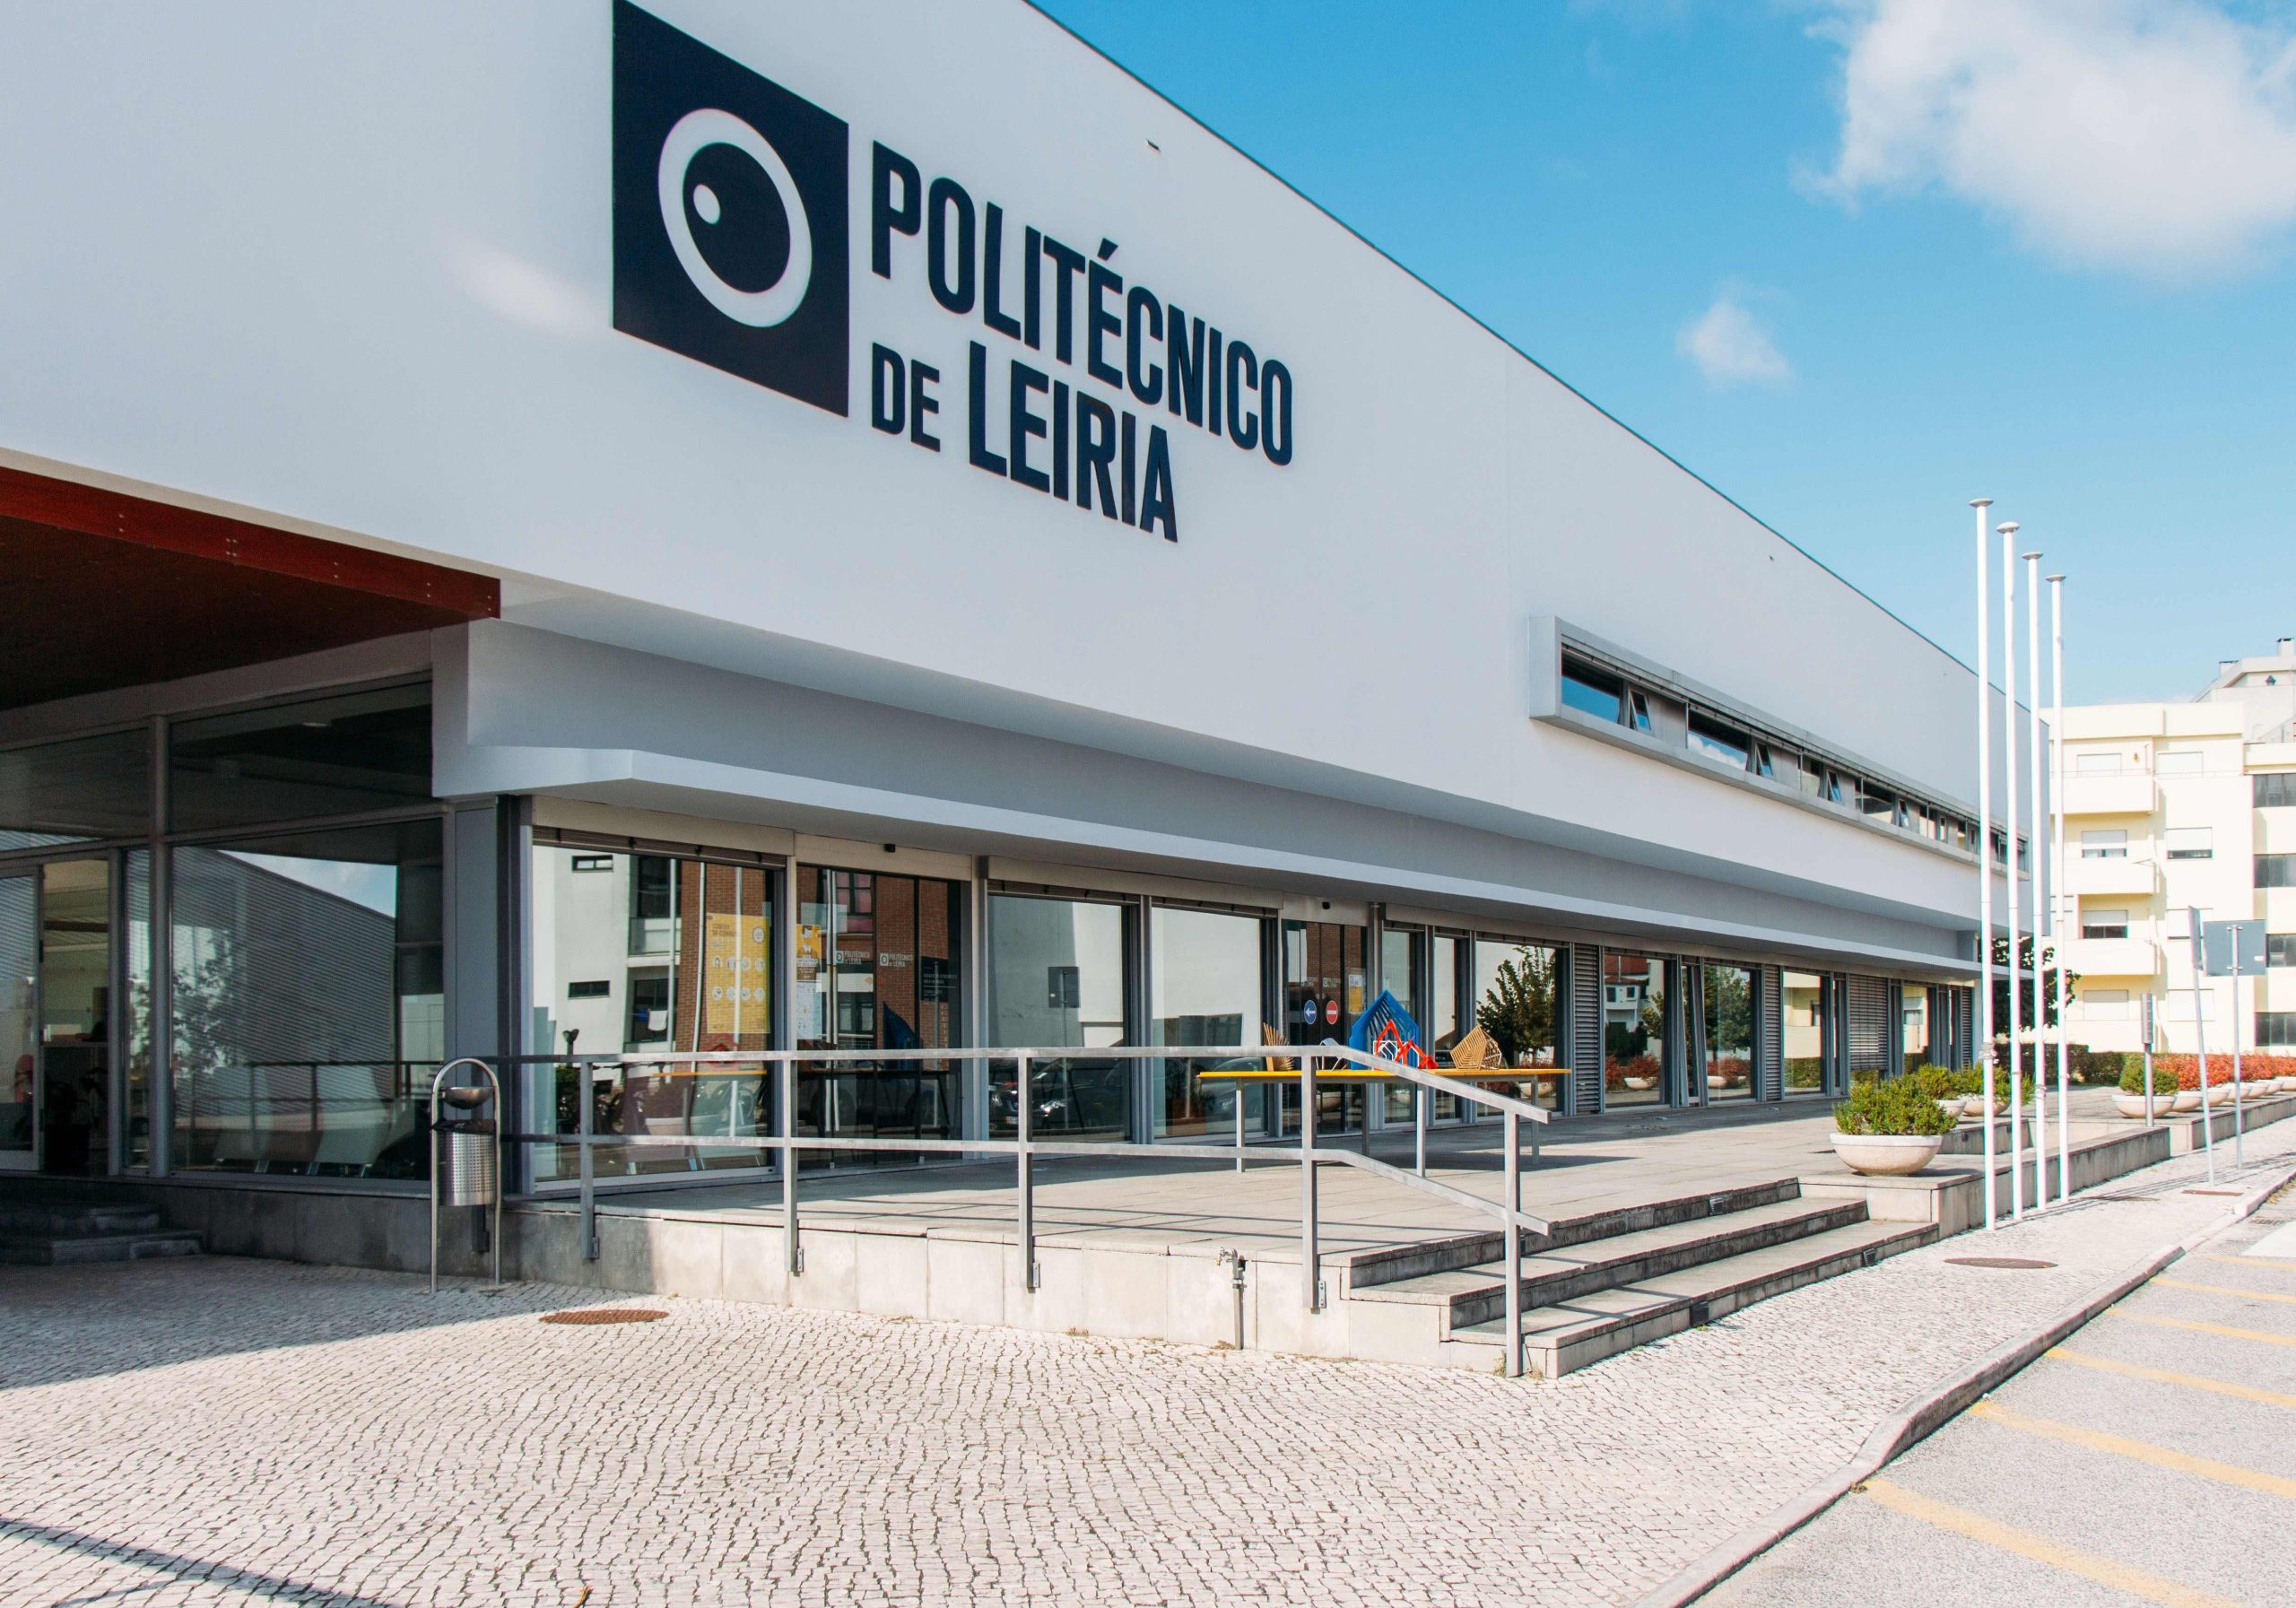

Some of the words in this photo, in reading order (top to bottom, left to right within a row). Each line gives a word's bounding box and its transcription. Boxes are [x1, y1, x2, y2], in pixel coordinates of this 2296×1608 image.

[871, 140, 1293, 466] POLITÉCNICO
[871, 342, 941, 453] DE
[969, 340, 1178, 543] LEIRIA
